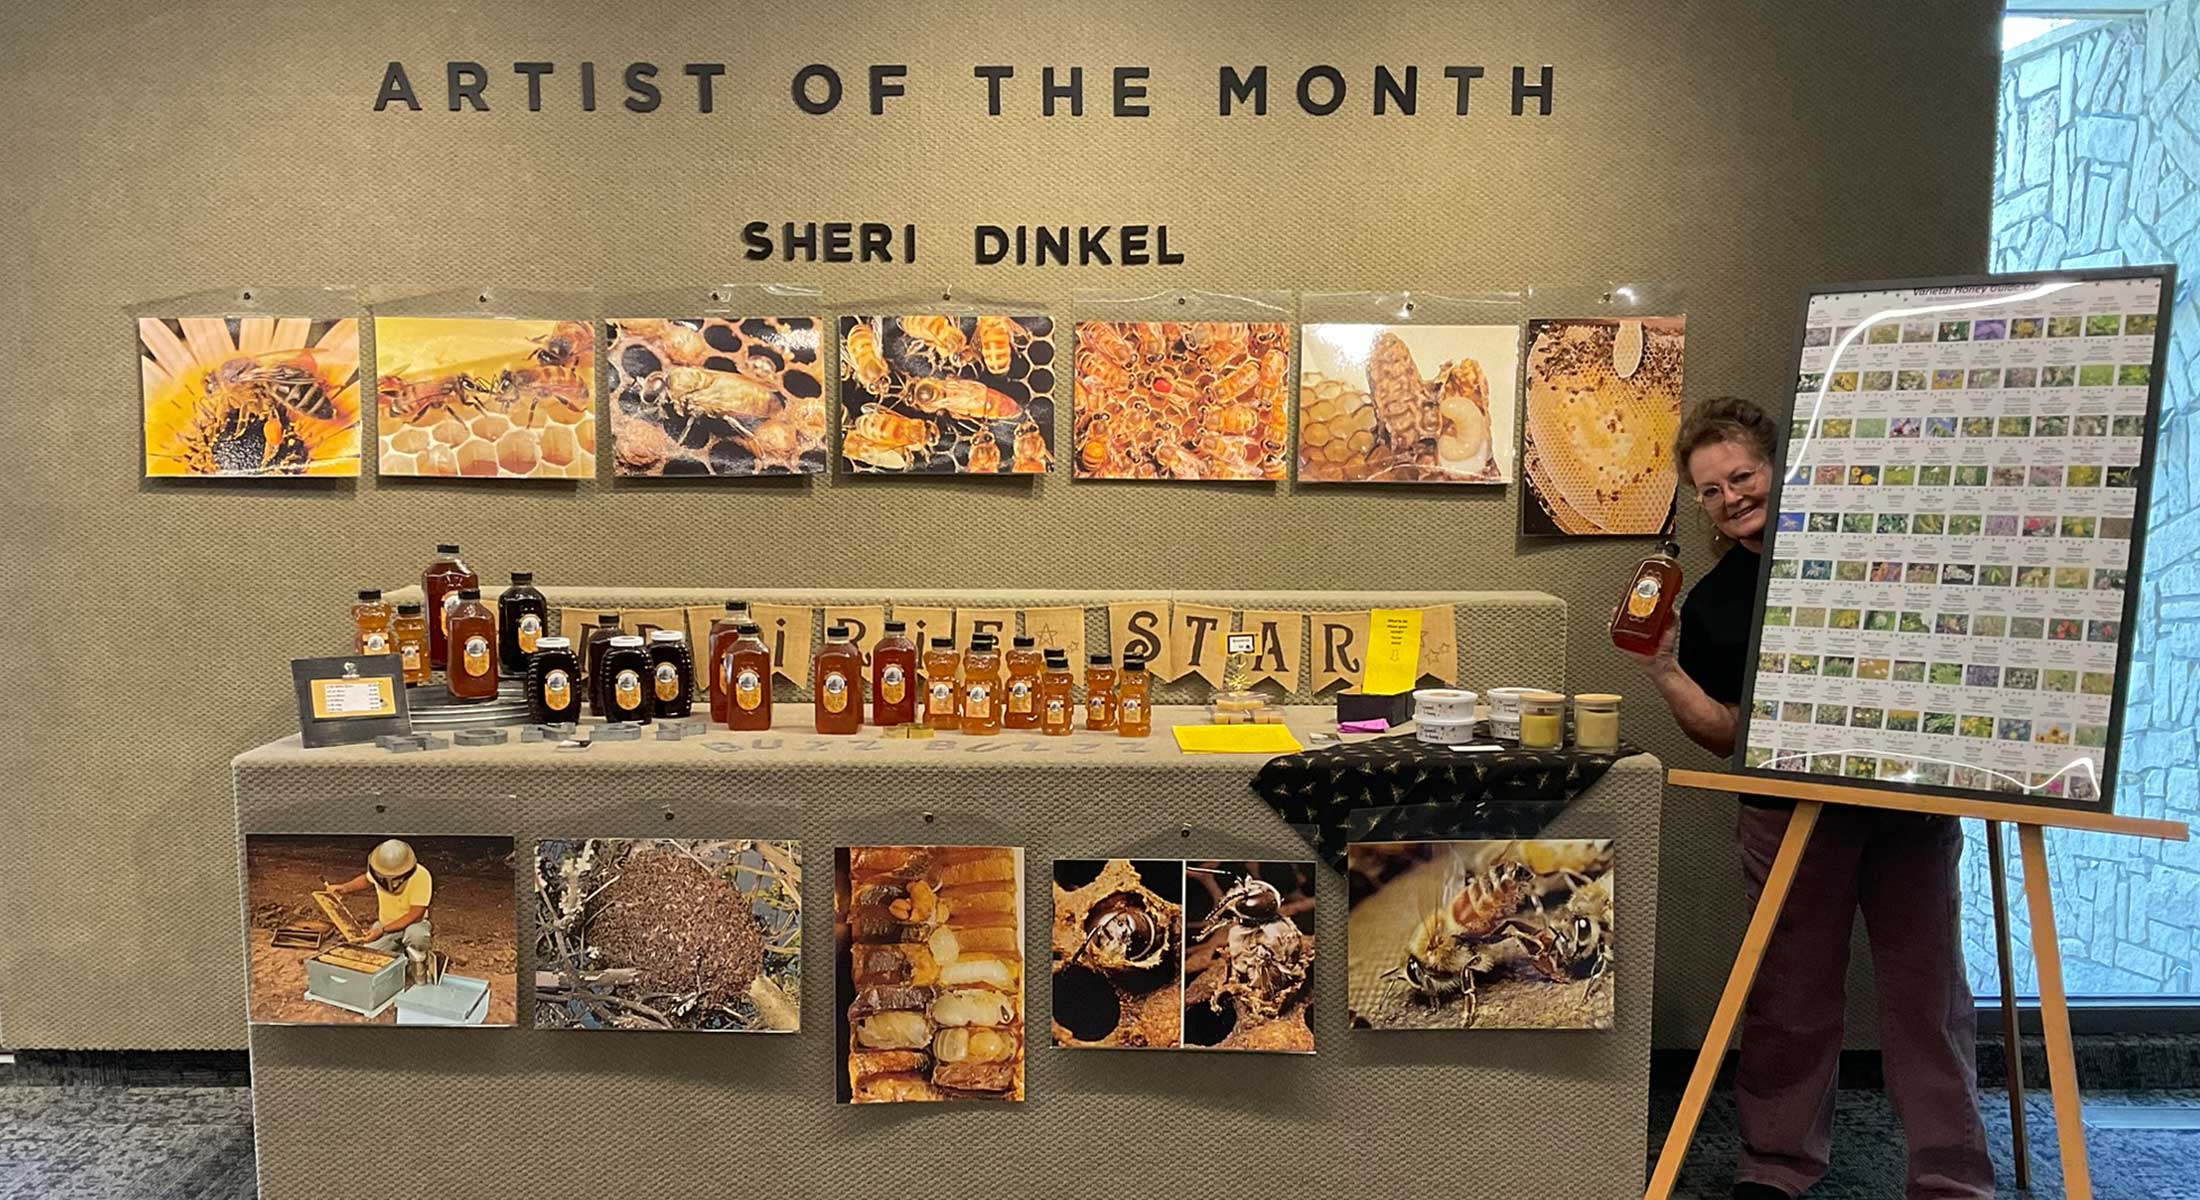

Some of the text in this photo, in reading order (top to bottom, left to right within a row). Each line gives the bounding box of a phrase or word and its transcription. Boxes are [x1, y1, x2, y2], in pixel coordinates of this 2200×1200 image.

[373, 61, 1554, 118] ARTIST OF THE MONTH
[743, 221, 1185, 266] SHERI DINKEL
[1954, 285, 1987, 295] Honey
[1124, 611, 1360, 673] STAR
